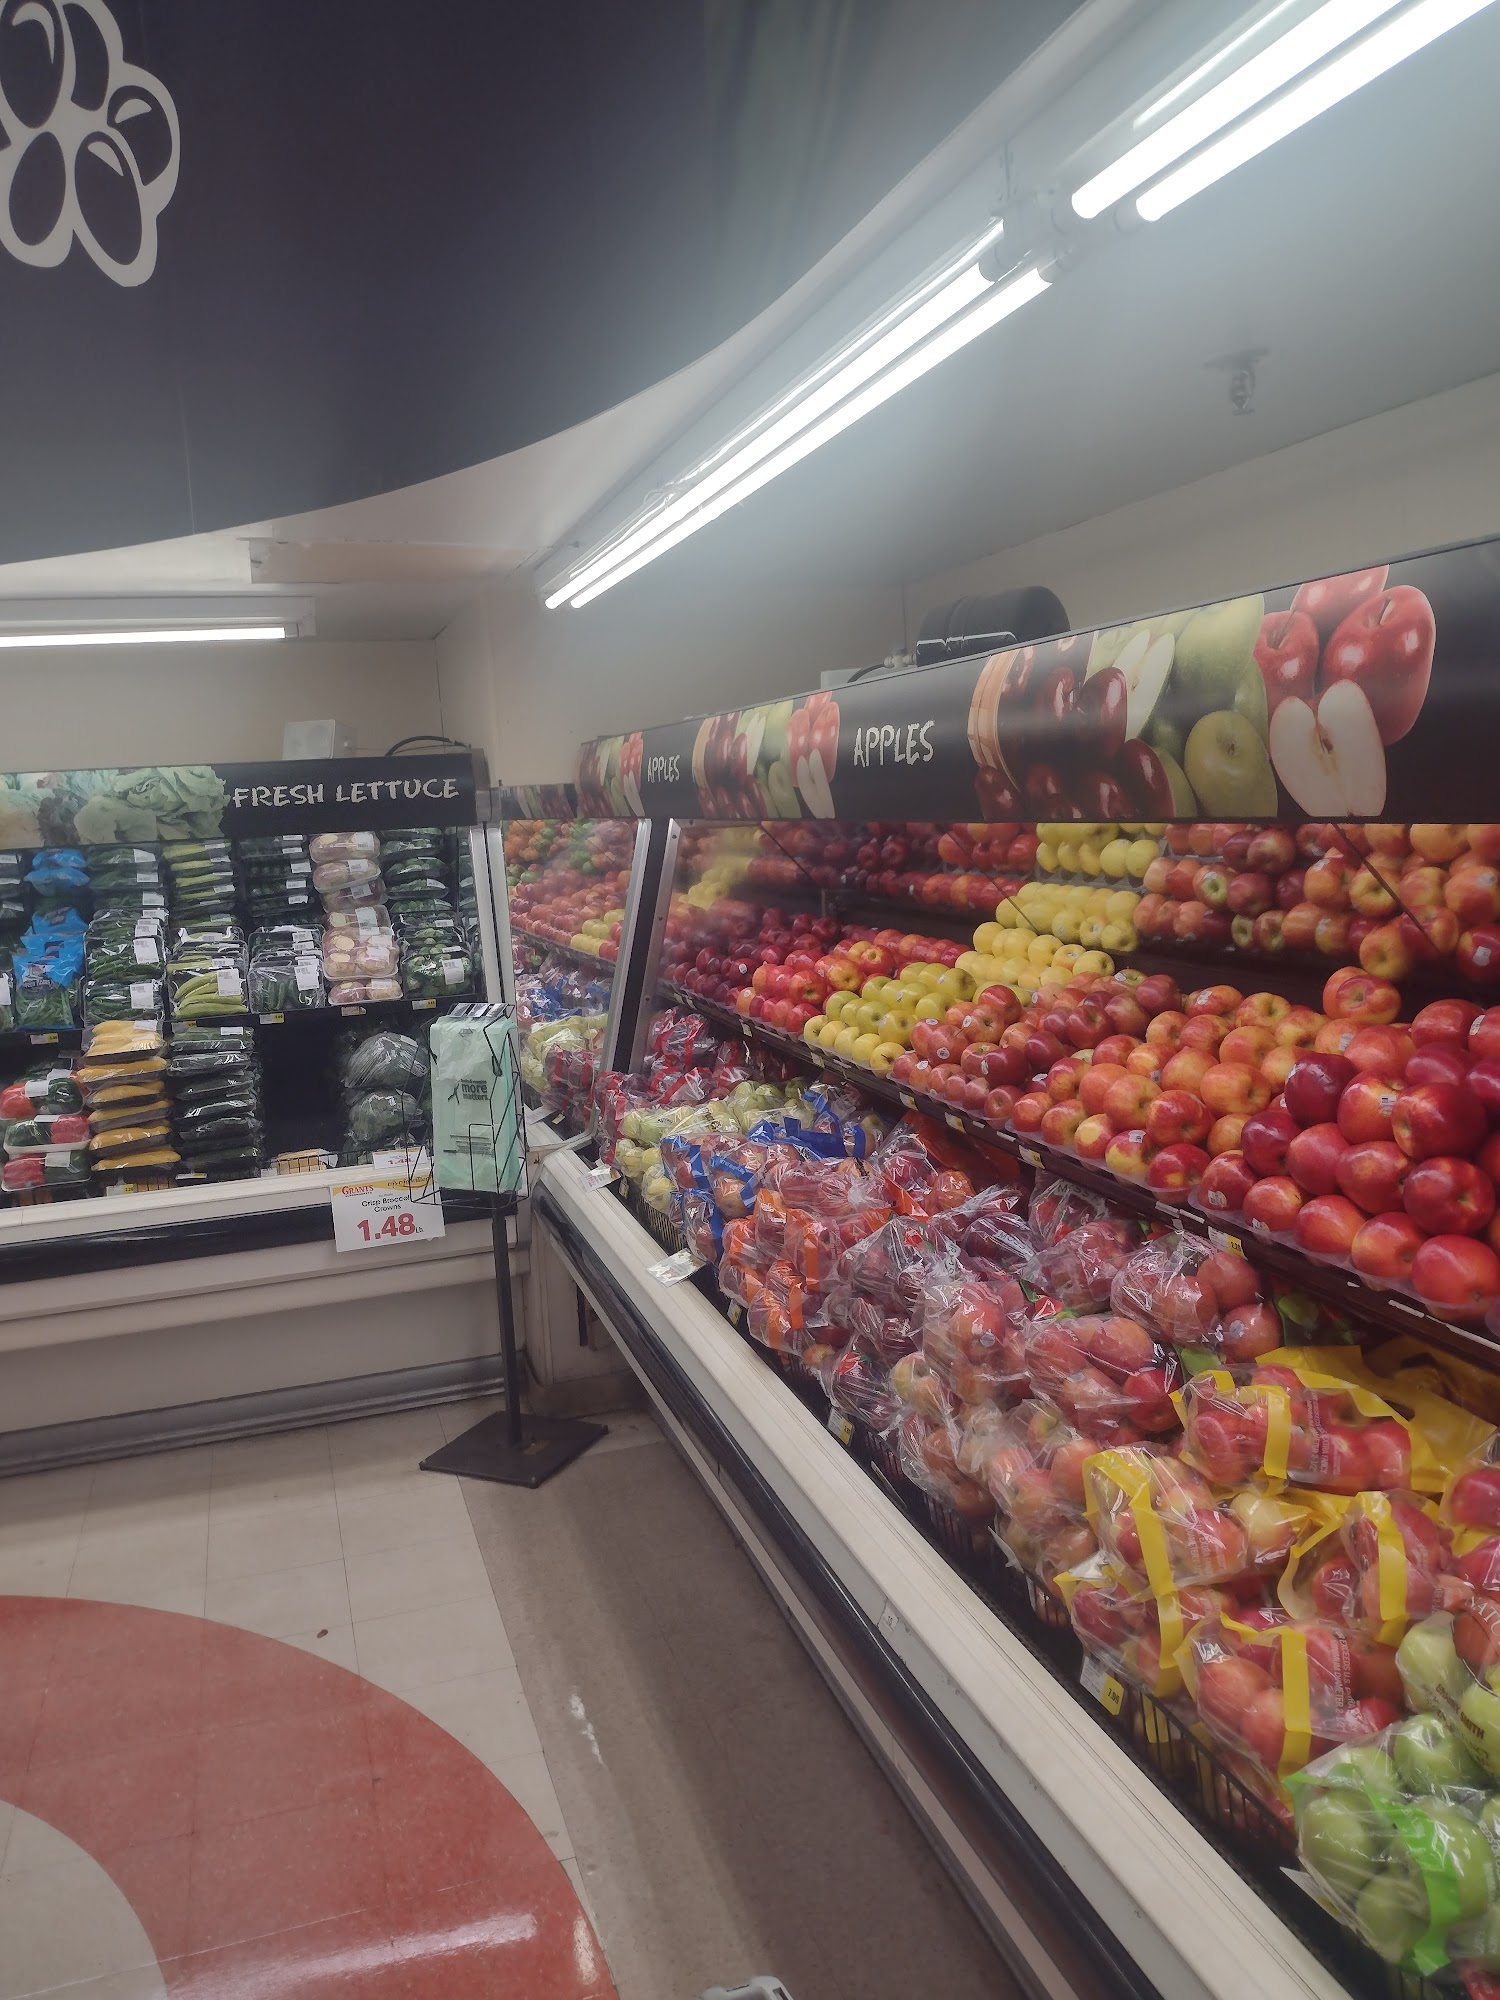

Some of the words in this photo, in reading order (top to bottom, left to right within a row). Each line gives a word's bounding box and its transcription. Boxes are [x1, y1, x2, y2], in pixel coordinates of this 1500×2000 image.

[852, 720, 935, 767] APPLES
[647, 755, 680, 783] APPLES
[233, 784, 325, 808] FRESH
[335, 778, 459, 803] LETTUCE
[462, 1084, 488, 1093] more
[374, 1204, 402, 1213] Crowns
[382, 1195, 411, 1204] Broccol
[357, 1213, 416, 1241] 1.48
[1339, 1639, 1351, 1671] EXCEEDS
[1343, 1671, 1351, 1685] U.S.
[1459, 1711, 1485, 1741] SMITH
